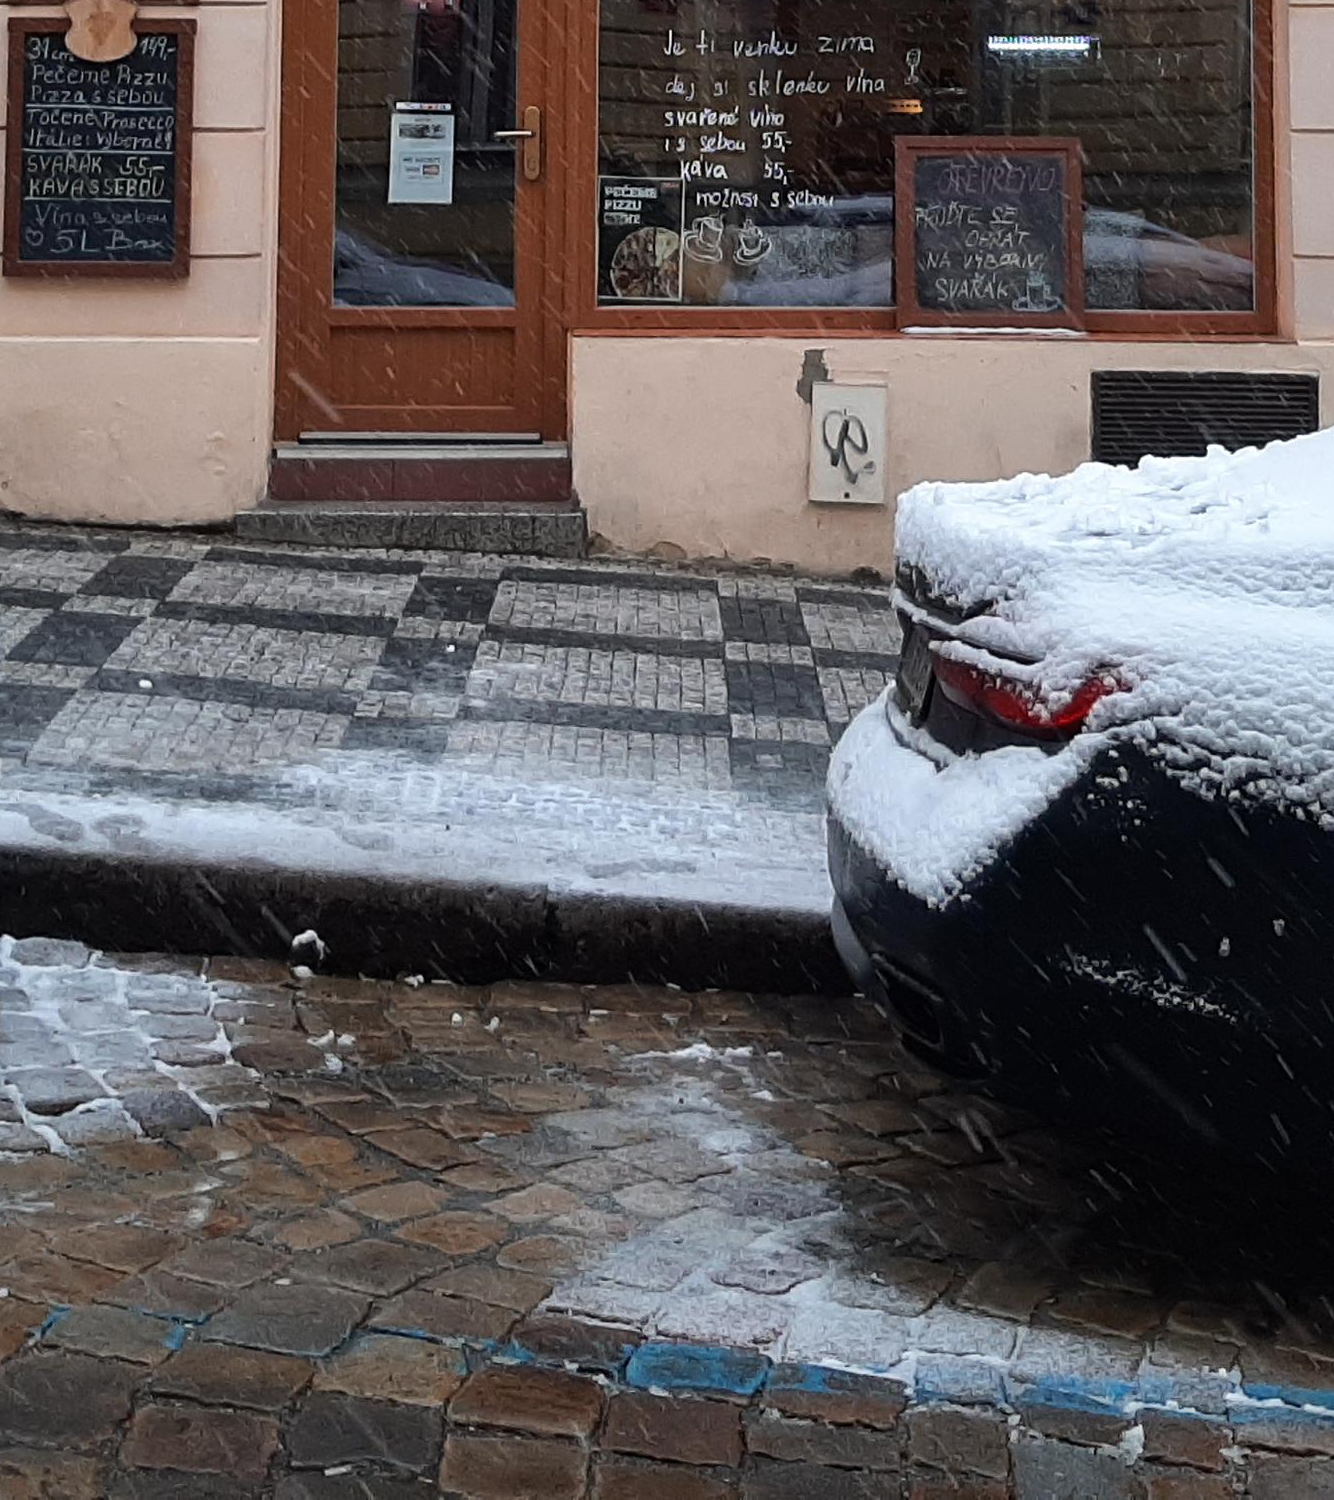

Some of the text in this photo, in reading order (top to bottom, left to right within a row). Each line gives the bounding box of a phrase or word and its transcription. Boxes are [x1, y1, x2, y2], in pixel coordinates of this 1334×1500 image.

[664, 29, 874, 58] Je ti venku zima
[32, 64, 110, 85] Pečeme
[747, 69, 831, 96] sklenku
[31, 85, 85, 102] Pizza
[107, 87, 164, 104] sebou
[102, 110, 175, 130] Prosecco
[699, 131, 747, 153] sebou
[103, 178, 165, 197] SEBOU
[989, 206, 1019, 224] SE
